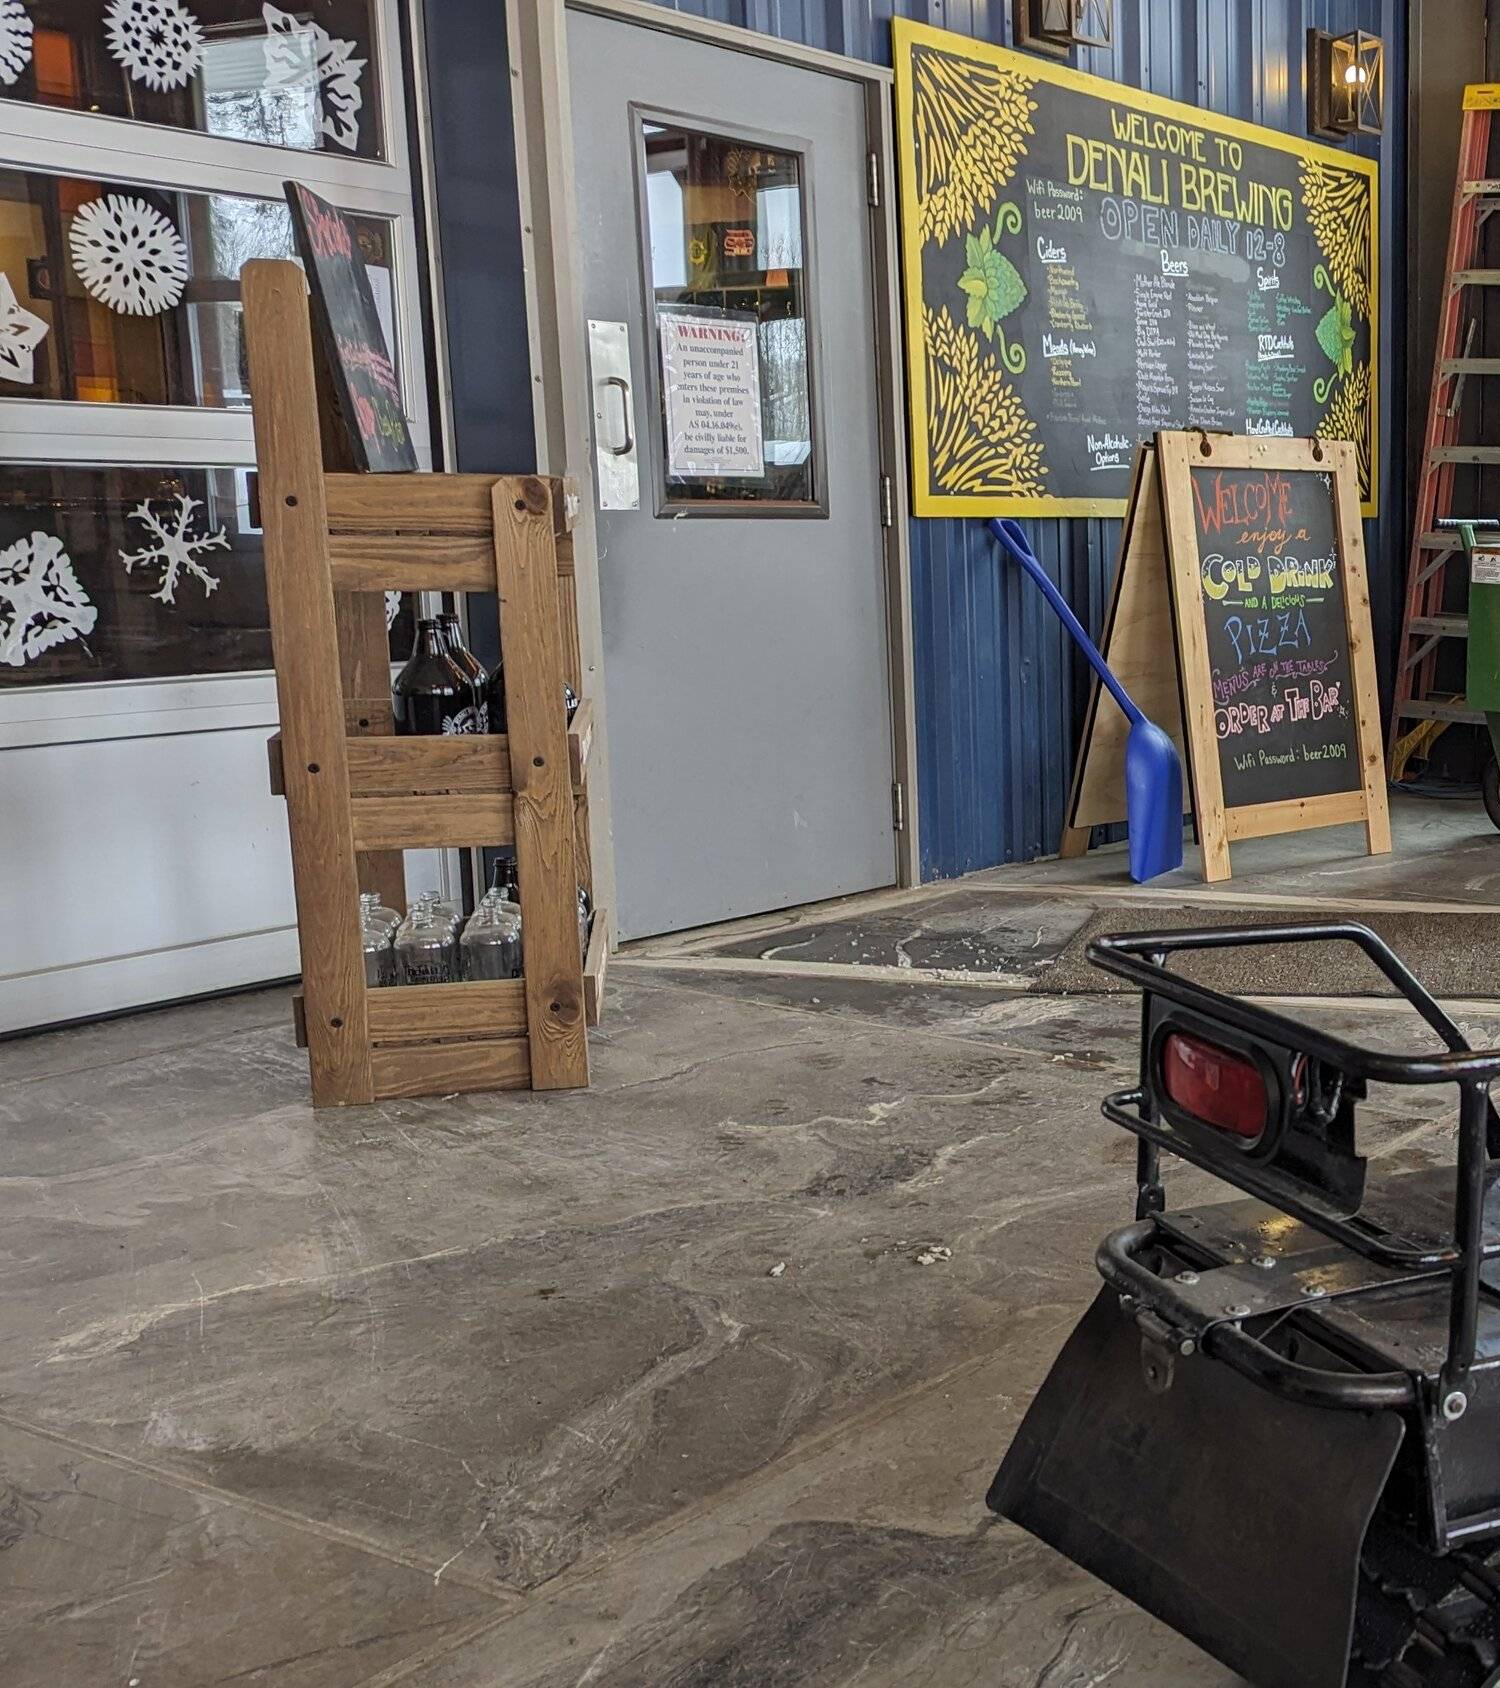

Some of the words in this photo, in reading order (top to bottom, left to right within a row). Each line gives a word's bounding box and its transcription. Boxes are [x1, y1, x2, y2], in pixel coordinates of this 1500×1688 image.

[1111, 108, 1207, 164] WELCOME
[1215, 138, 1243, 171] TO
[1026, 178, 1045, 195] Wifi
[1047, 180, 1084, 201] Password:
[1066, 133, 1170, 205] DENALI
[1180, 163, 1293, 231] BREWING
[1100, 197, 1179, 248] OPEN
[1187, 215, 1241, 256] DAILY
[1246, 228, 1285, 268] 12-8
[1036, 236, 1067, 260] Ciders
[1160, 249, 1189, 274] Beers
[1256, 266, 1280, 289] Spirits
[676, 343, 688, 351] An
[689, 345, 744, 356] unaccompanied
[683, 359, 707, 368] person
[708, 359, 730, 369] under
[731, 360, 739, 369] 21
[683, 371, 703, 380] years
[703, 371, 712, 380] of
[712, 374, 725, 382] age
[726, 373, 741, 382] who
[699, 383, 717, 392] these
[719, 386, 750, 395] premises
[683, 394, 690, 403] in
[692, 395, 722, 405] violation
[723, 397, 731, 405] of
[732, 397, 744, 406] law
[688, 420, 700, 429] AS
[695, 410, 712, 419] may,
[684, 432, 694, 441] be
[695, 433, 715, 444] civilly
[717, 433, 735, 442] liable
[736, 434, 747, 443] for
[684, 445, 715, 455] damages
[716, 446, 724, 454] of
[1095, 451, 1120, 466] Options
[1191, 471, 1293, 535] WELCOME
[1236, 526, 1292, 554] enjoy
[1295, 529, 1311, 541] a
[1244, 599, 1258, 608] AND
[1261, 599, 1267, 610] A
[1271, 594, 1305, 609] DELICIOUS
[1223, 609, 1312, 665] PIZZA
[1253, 663, 1267, 678] ARE
[1269, 662, 1279, 679] ON
[1280, 660, 1294, 672] THE
[1214, 702, 1270, 739] ORDER
[1270, 704, 1285, 723] AT
[1285, 688, 1310, 722] THE
[1310, 680, 1340, 721] BAR
[1234, 753, 1256, 771] Wifi
[1258, 749, 1300, 766] Password:
